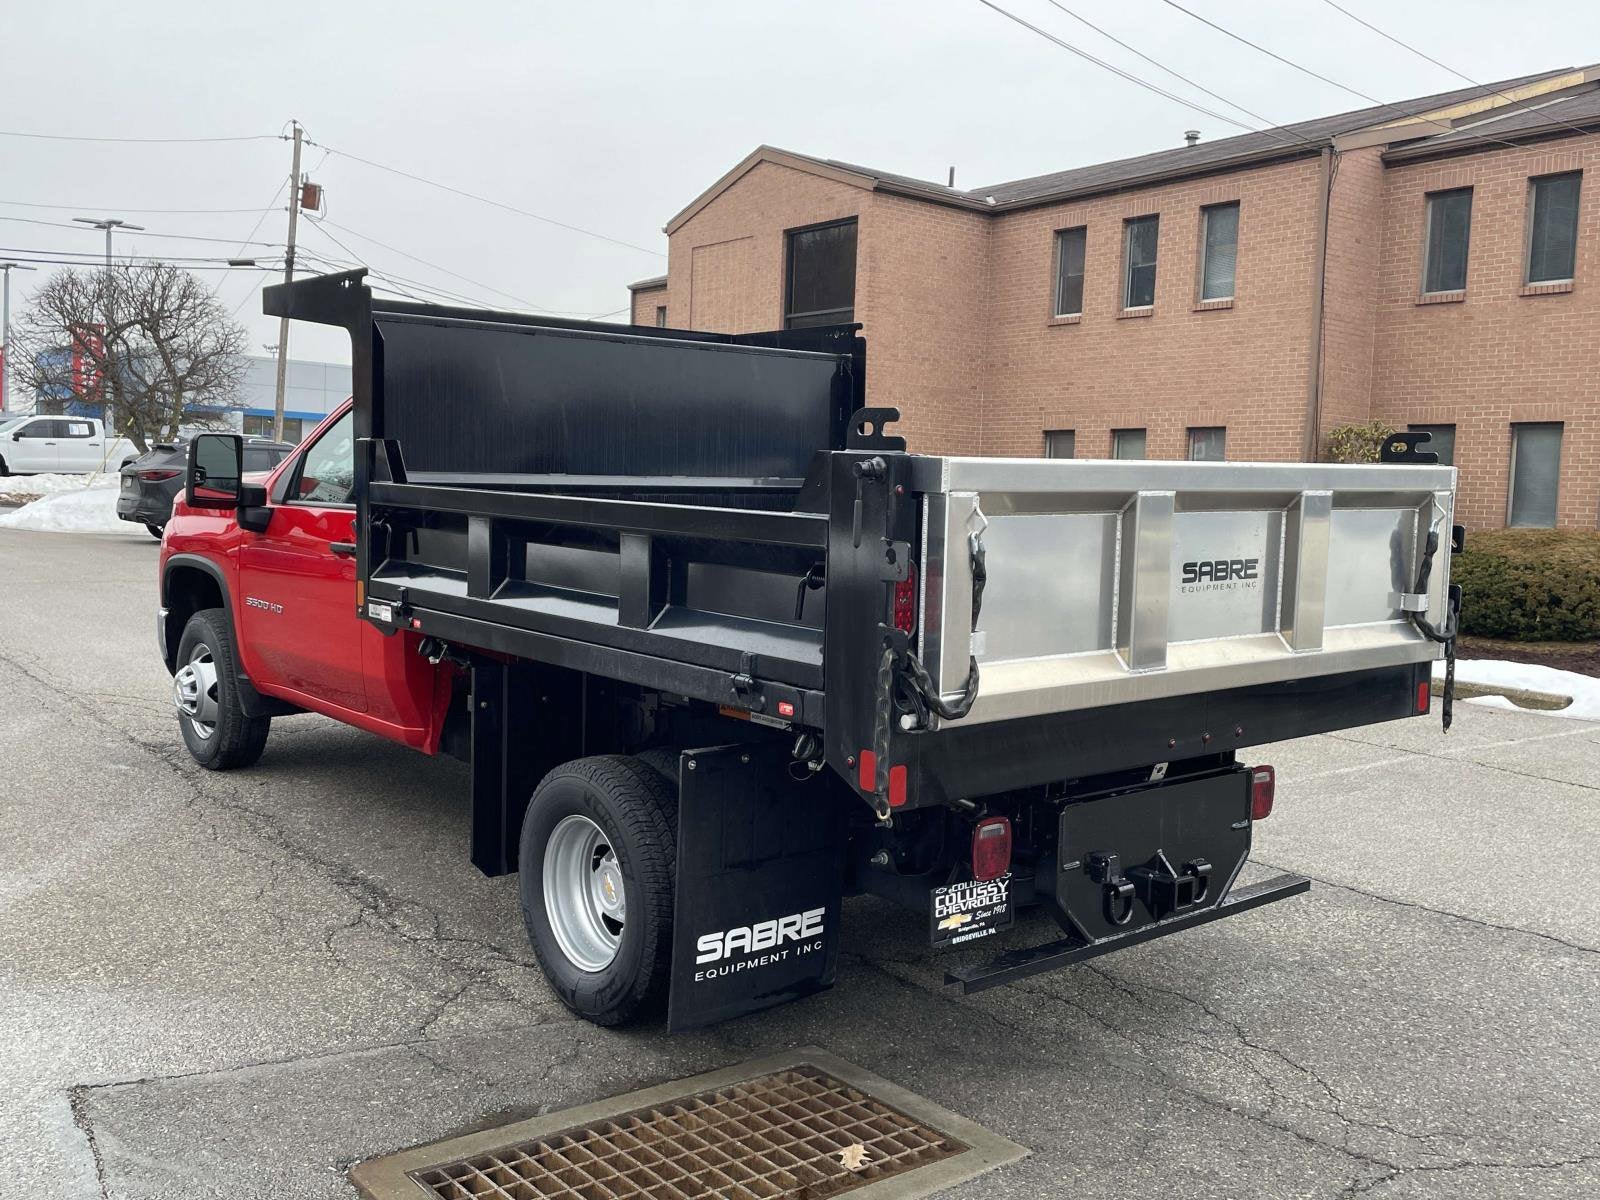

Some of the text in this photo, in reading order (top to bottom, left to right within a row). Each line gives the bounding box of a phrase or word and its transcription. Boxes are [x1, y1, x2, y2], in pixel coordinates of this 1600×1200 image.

[1182, 558, 1258, 583] SABRE
[1181, 581, 1257, 593] EQUIPMENT INC
[270, 602, 283, 614] HD
[935, 880, 1009, 909] COLUSSY
[935, 892, 1008, 918] CHEVROLET
[975, 910, 992, 920] Since
[696, 907, 825, 965] SABRE
[694, 941, 822, 982] EQUIPMENT INC
